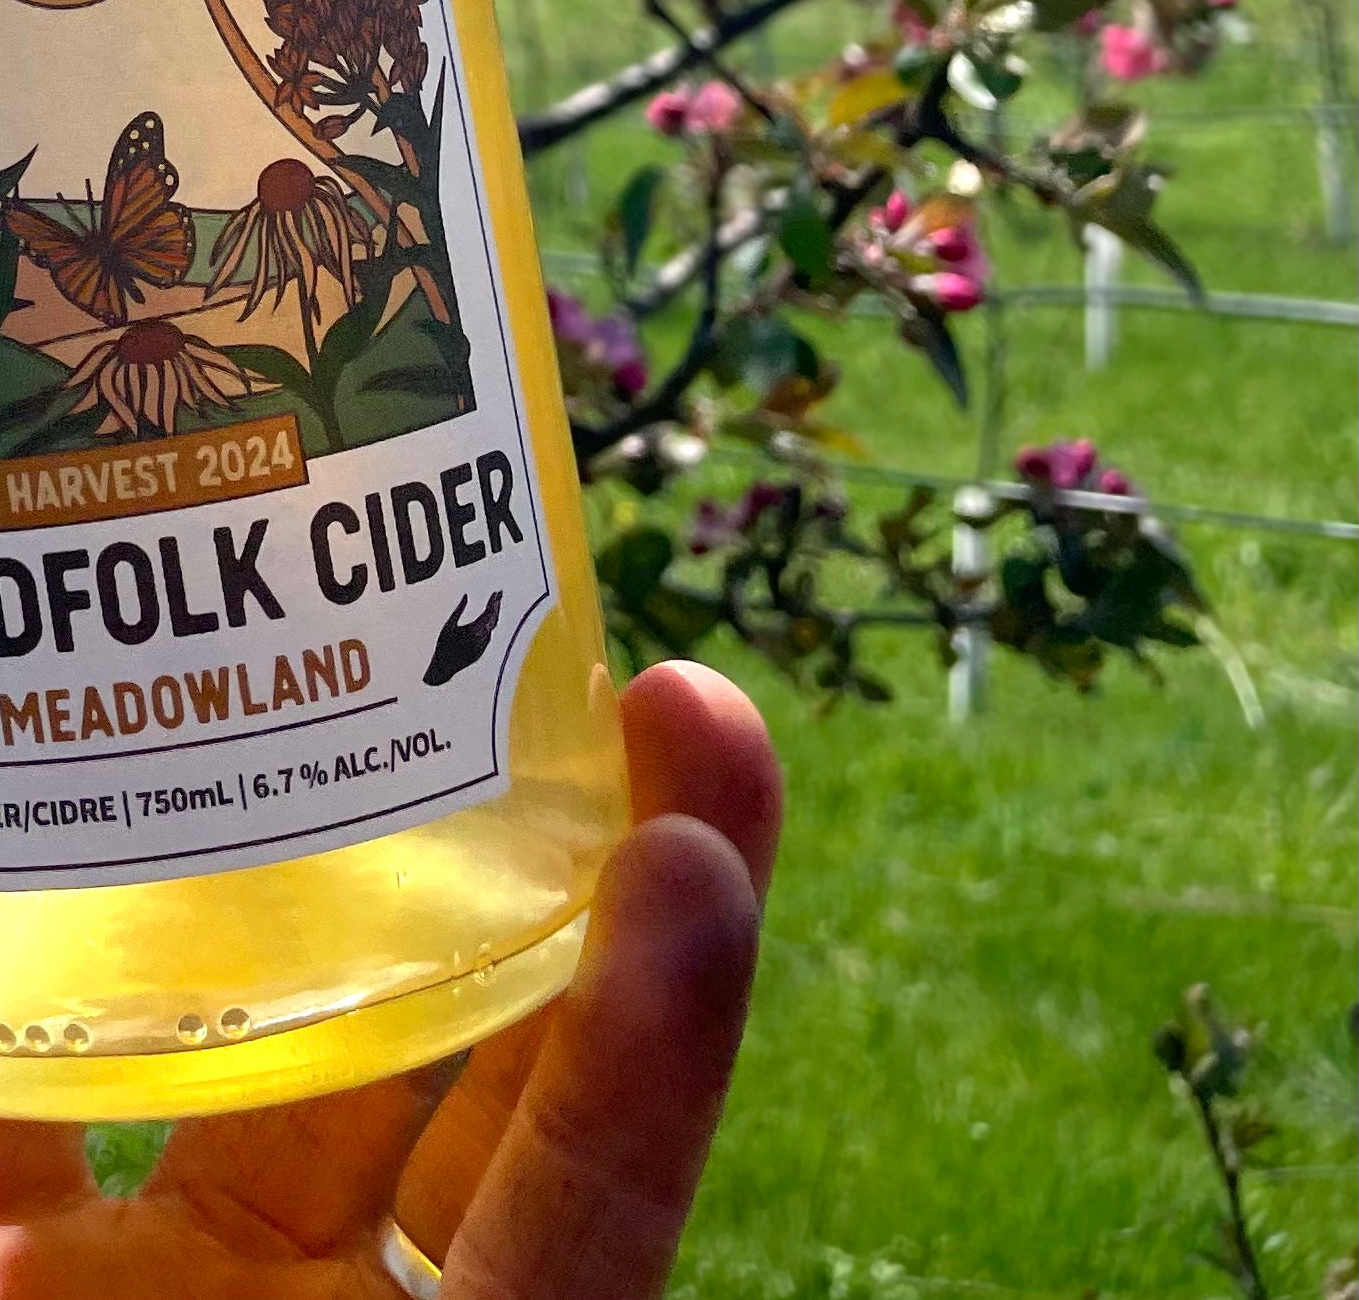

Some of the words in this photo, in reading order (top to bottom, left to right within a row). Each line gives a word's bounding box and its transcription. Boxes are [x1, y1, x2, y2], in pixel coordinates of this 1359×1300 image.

[6, 452, 179, 514] HARVEST
[198, 432, 295, 488] 2024
[310, 449, 524, 606] CIDER
[136, 781, 233, 817] 750mL
[333, 729, 452, 781] ALC./VOL.
